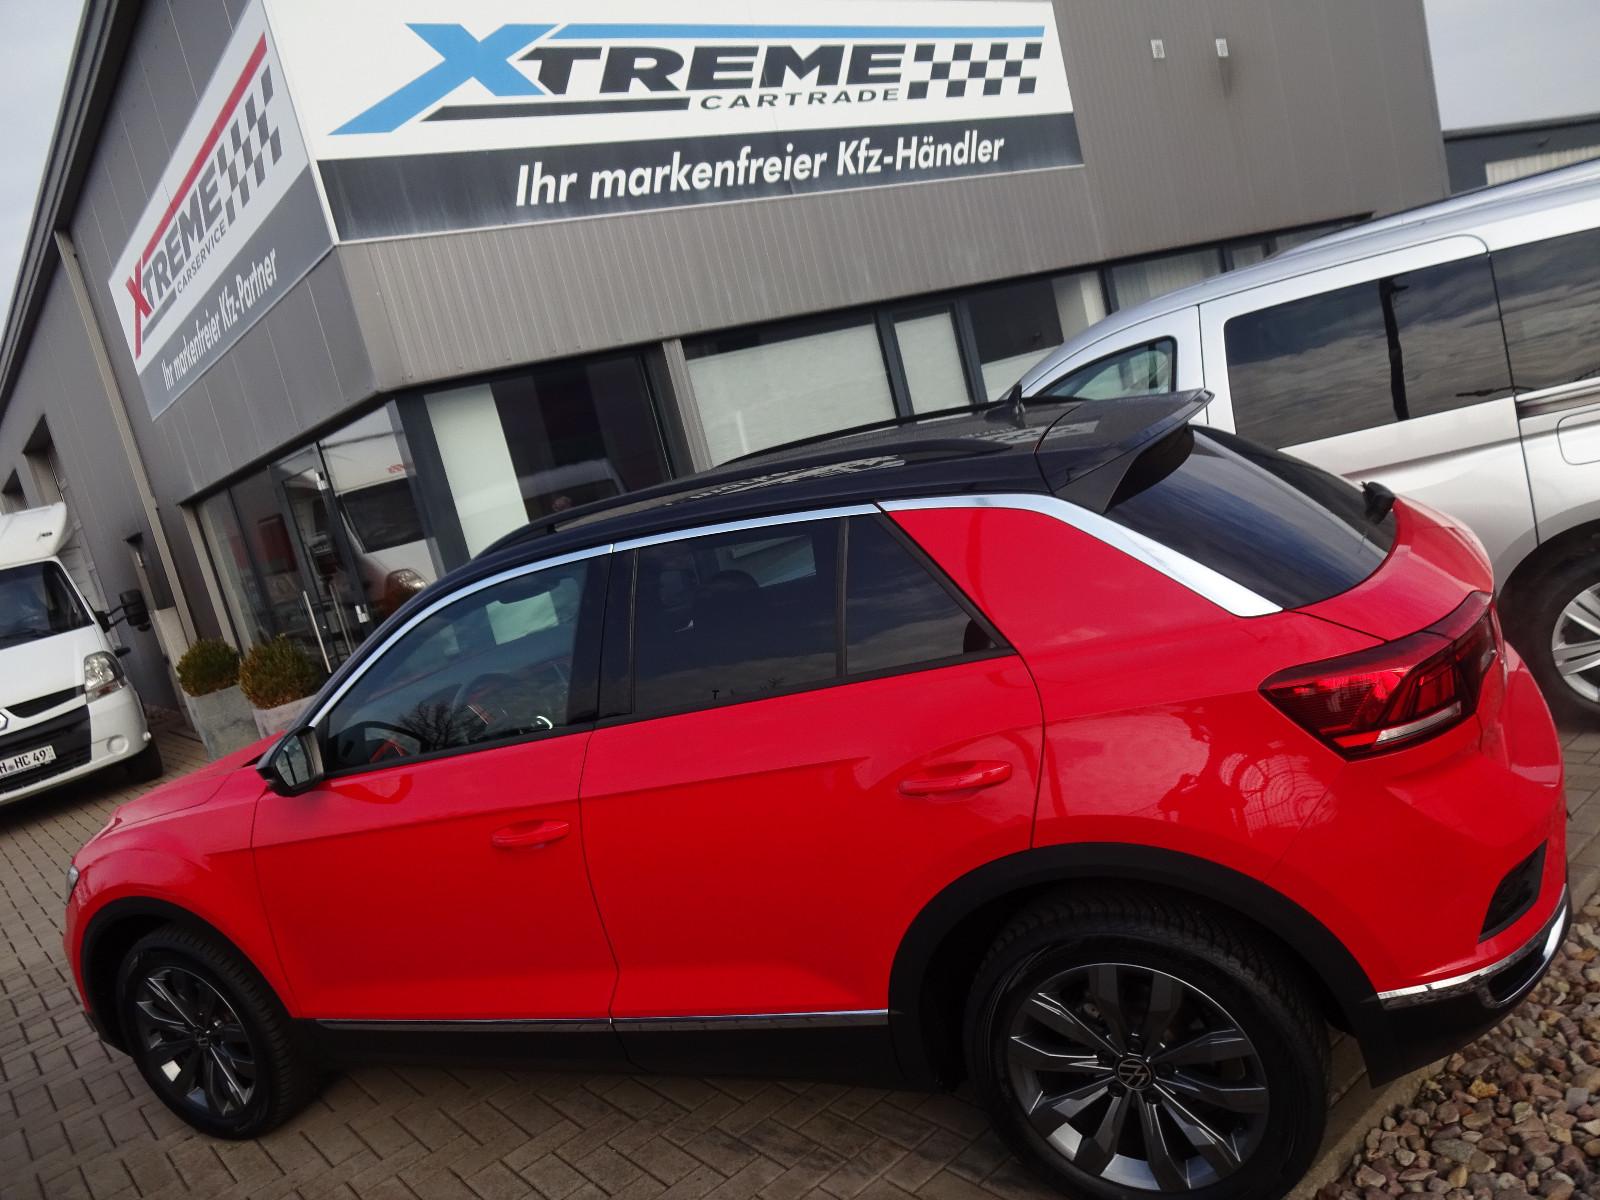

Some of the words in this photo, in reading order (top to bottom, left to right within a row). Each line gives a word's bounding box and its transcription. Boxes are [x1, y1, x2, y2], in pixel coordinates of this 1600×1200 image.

[326, 23, 906, 136] XTREME
[699, 88, 900, 111] CARTRADE
[515, 161, 578, 207] Ihr
[590, 142, 828, 200] markenfreier
[836, 129, 1005, 176] Kfz-Händler
[125, 160, 223, 360] XTREME
[177, 220, 227, 294] CARSERVICE
[162, 360, 175, 391] Ihr
[173, 309, 222, 381] markenfreier
[218, 248, 278, 332] Kfz-Partner
[14, 754, 31, 769] HC
[33, 750, 47, 763] 49
